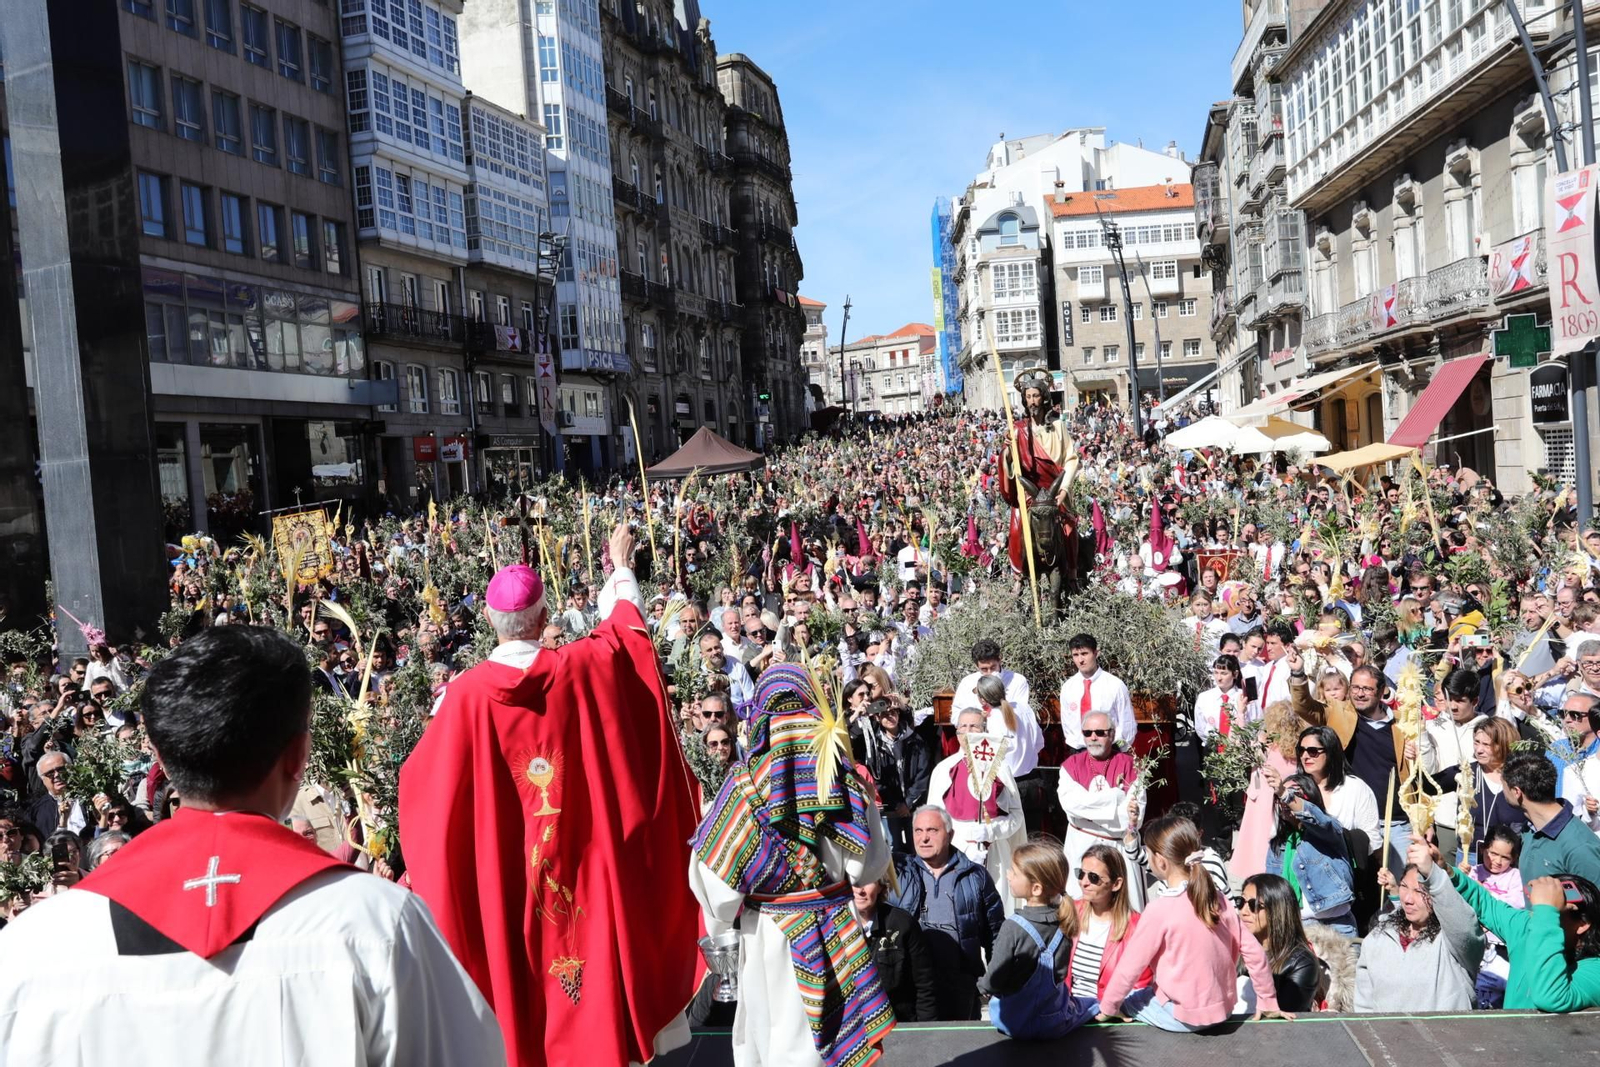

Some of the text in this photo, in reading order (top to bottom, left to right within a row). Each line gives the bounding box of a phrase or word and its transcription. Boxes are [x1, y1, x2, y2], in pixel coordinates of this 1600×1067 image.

[1491, 253, 1502, 279] R
[1556, 252, 1593, 308] R
[1063, 301, 1071, 339] HOTEL
[1560, 310, 1598, 337] 1809
[541, 386, 553, 409] R
[1531, 382, 1566, 399] FARMACIA
[1534, 404, 1547, 412] Puerta
